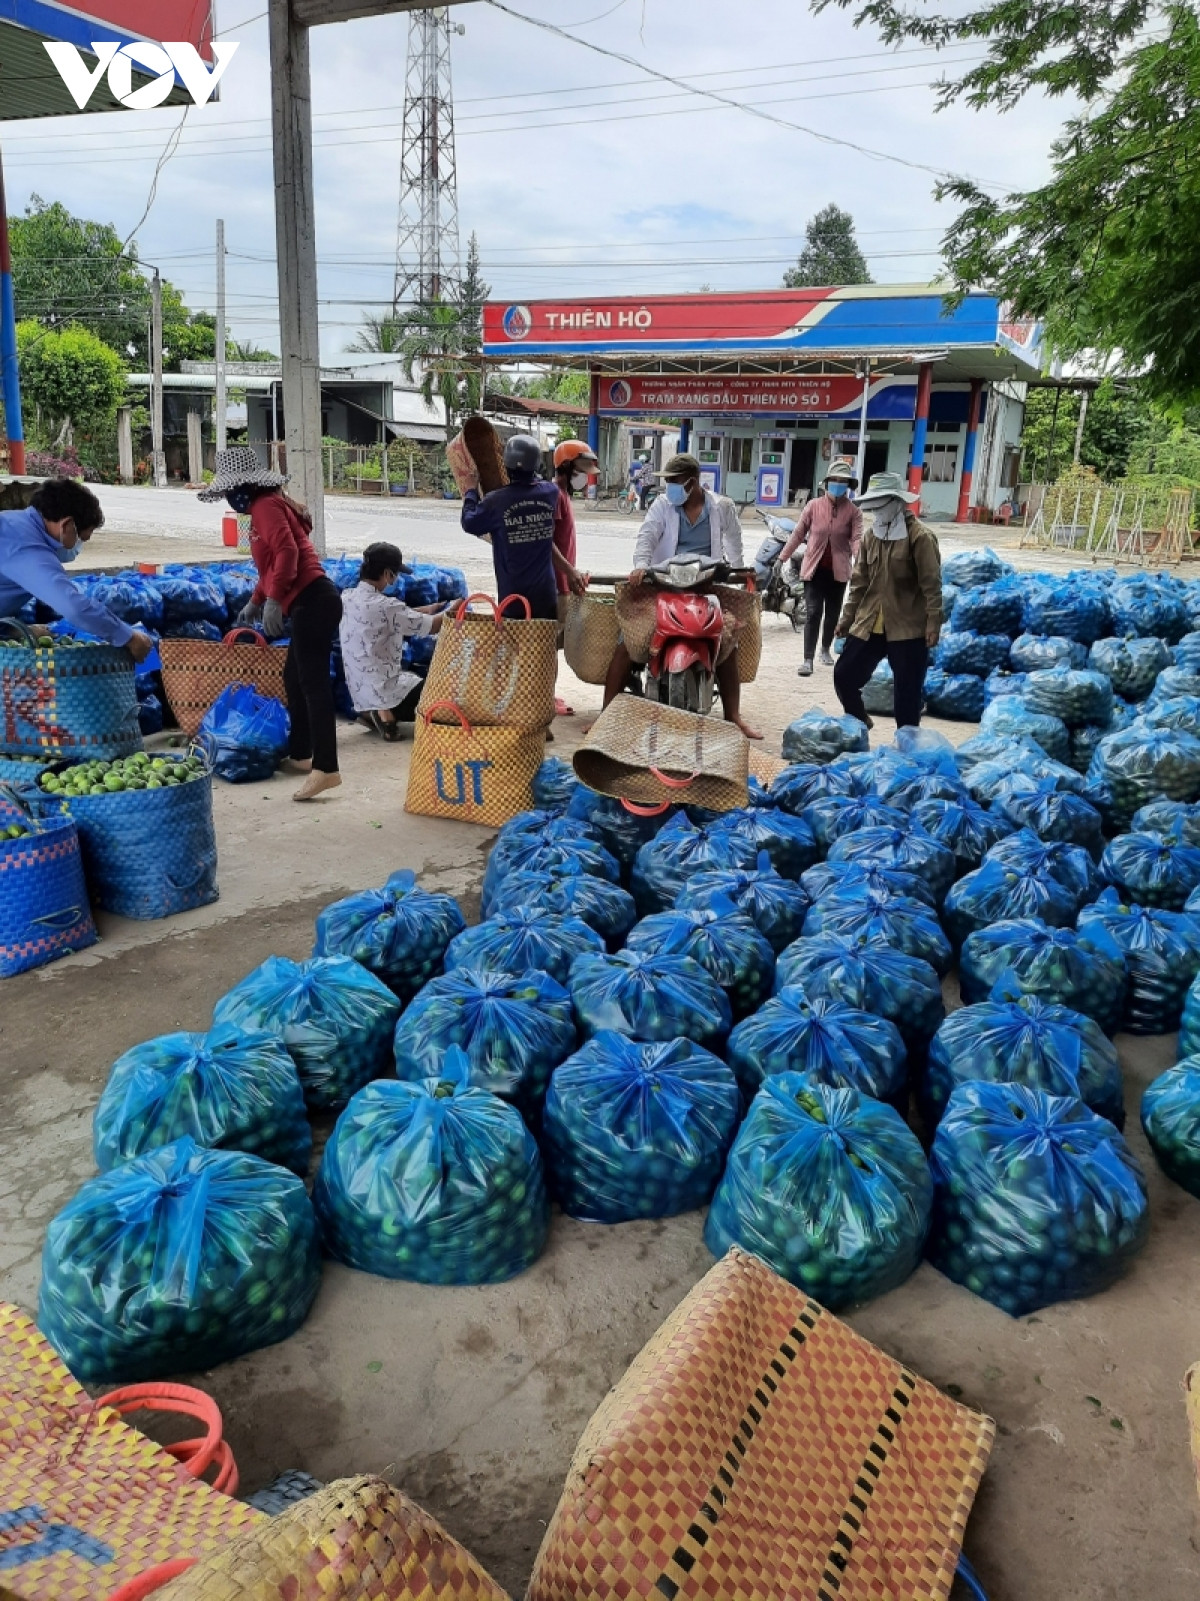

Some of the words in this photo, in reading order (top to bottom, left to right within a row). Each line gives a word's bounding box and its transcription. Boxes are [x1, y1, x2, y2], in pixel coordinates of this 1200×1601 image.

[545, 308, 611, 330] THIÊN
[618, 306, 652, 332] HỘ
[742, 393, 778, 405] THIÊN
[825, 394, 831, 406] 1
